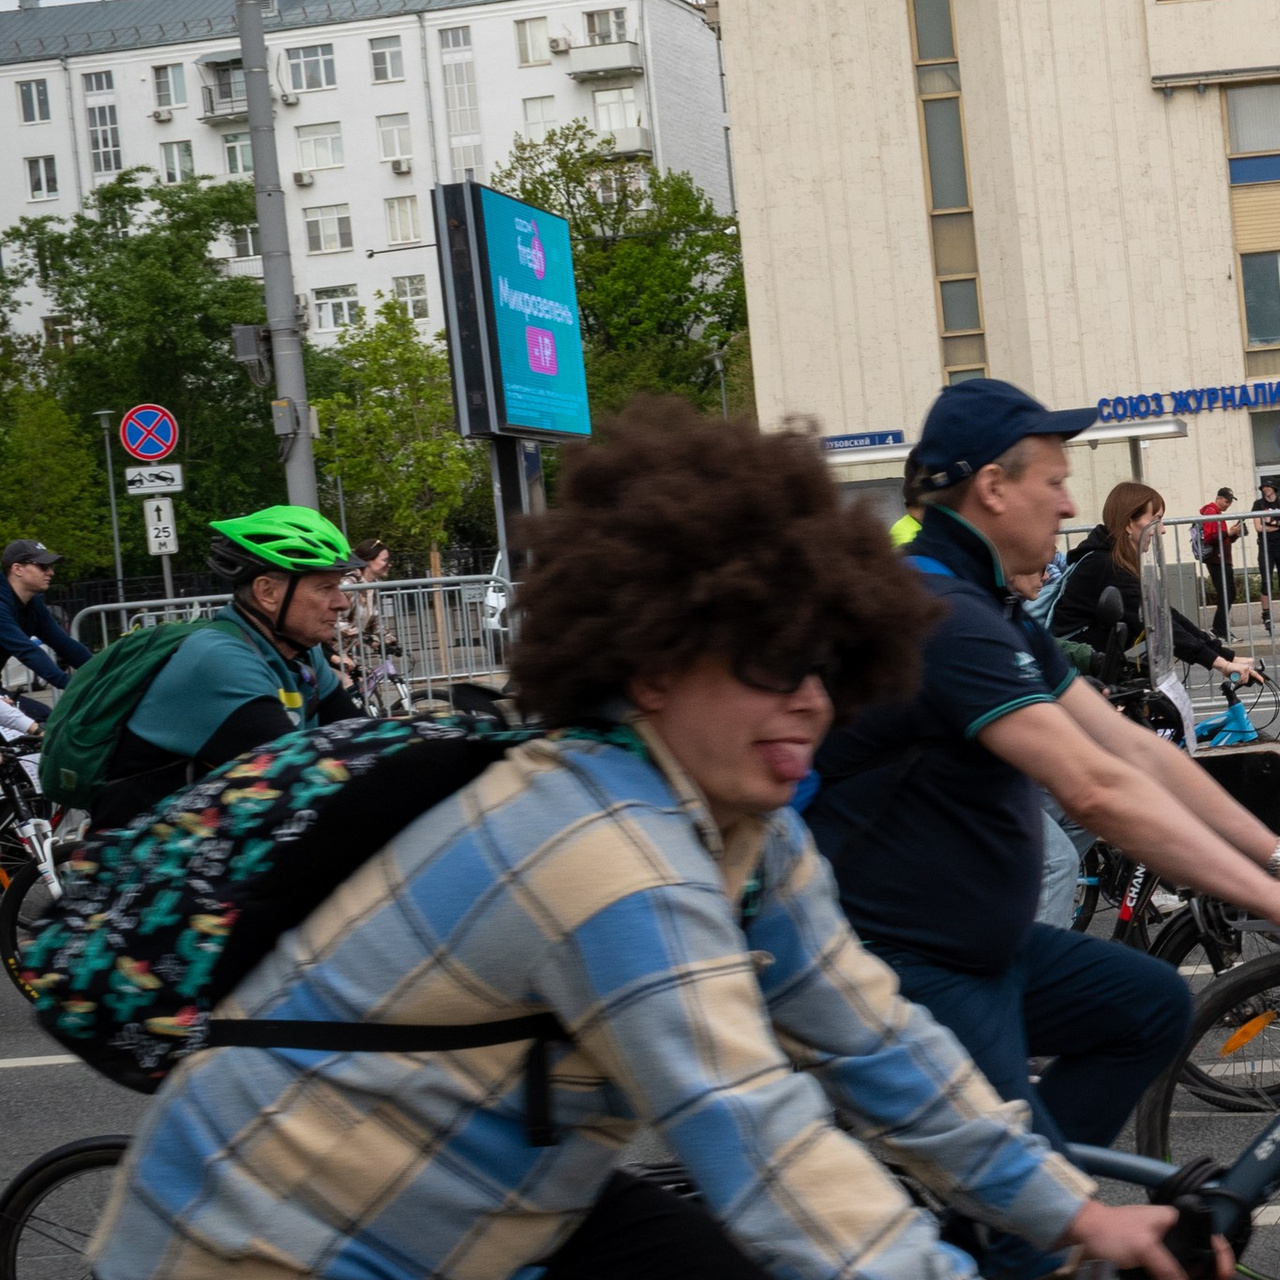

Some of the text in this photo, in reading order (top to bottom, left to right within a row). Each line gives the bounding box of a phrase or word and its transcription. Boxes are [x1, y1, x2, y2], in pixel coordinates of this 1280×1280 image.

[1097, 392, 1164, 421] СОЮЗ
[825, 434, 894, 450] ЗУБОВСКИЙ 4
[153, 526, 171, 539] 25
[1126, 862, 1146, 907] CHAN
